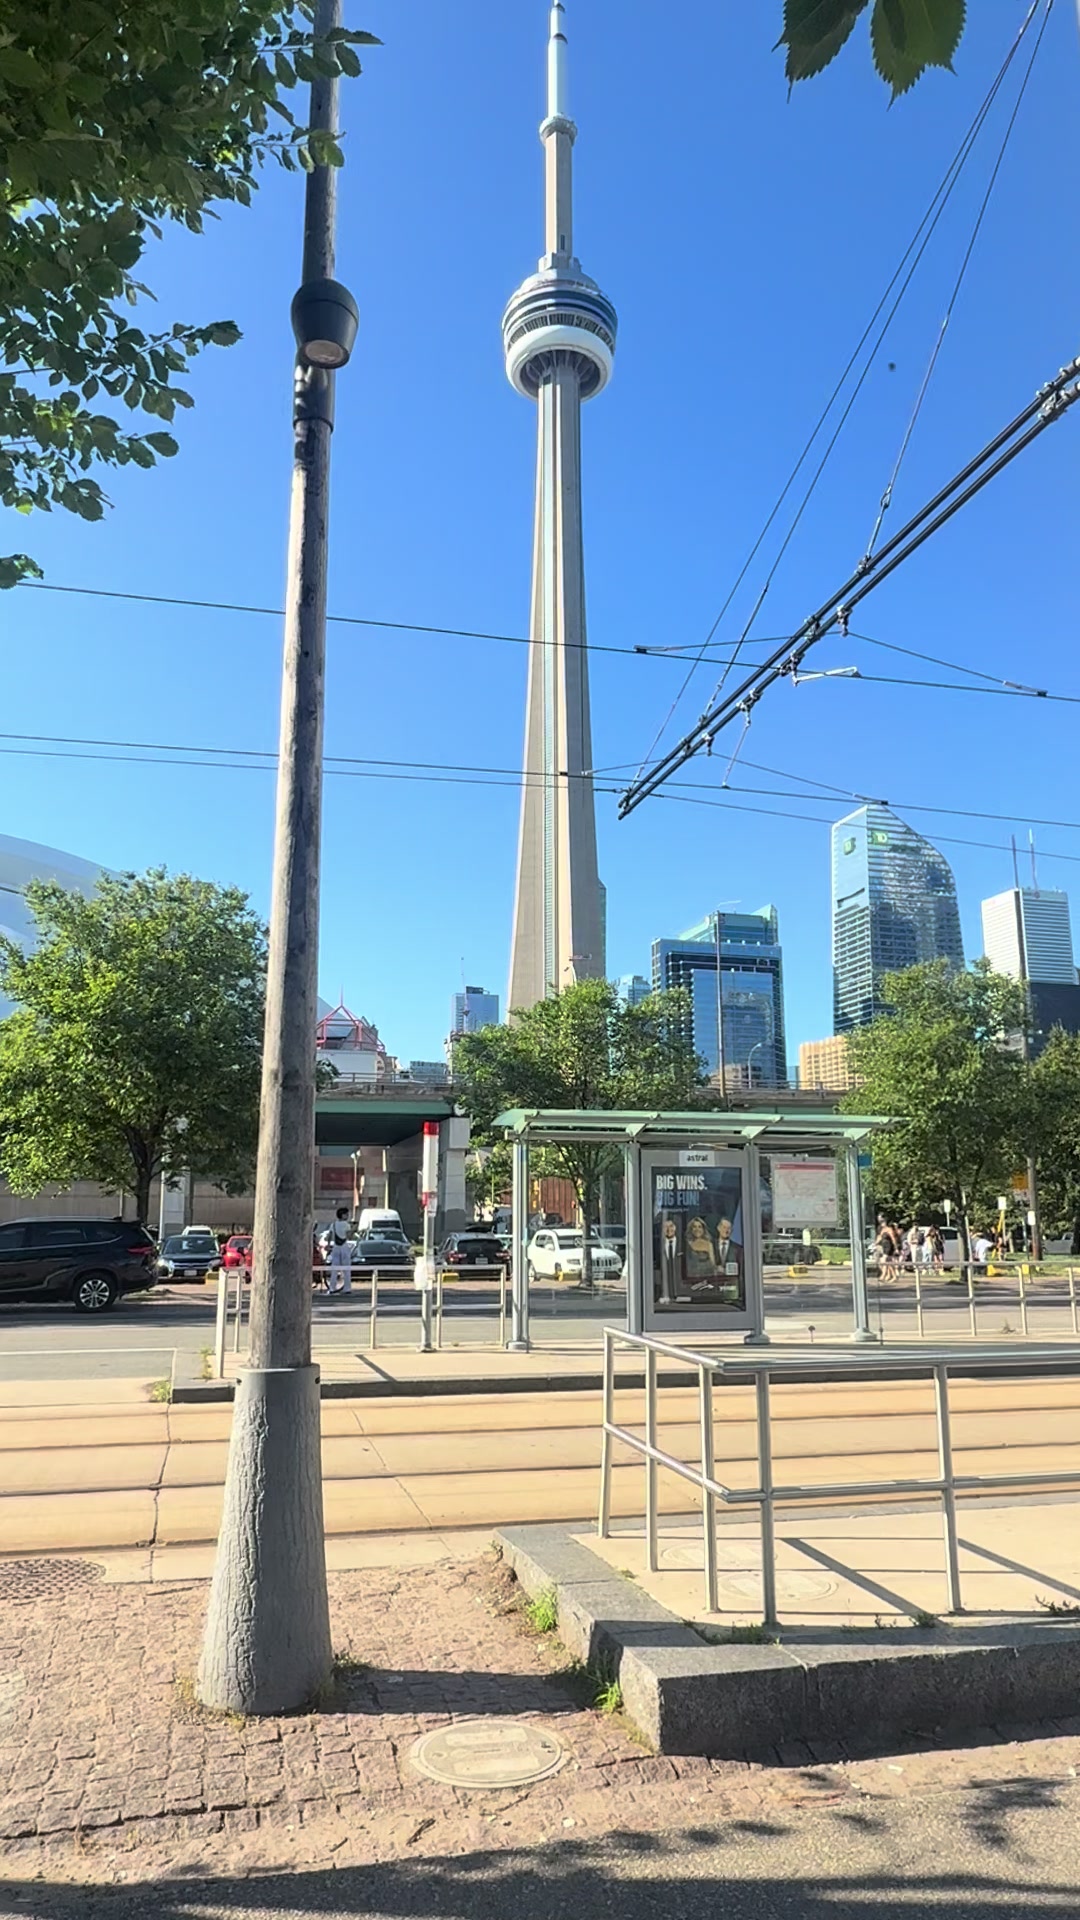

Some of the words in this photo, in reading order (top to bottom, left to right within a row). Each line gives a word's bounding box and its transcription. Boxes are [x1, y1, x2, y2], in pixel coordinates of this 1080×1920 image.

[686, 1154, 708, 1162] astral
[656, 1175, 674, 1190] BIG
[676, 1175, 708, 1190] WINS.
[657, 1191, 674, 1206] BIG
[677, 1191, 700, 1206] FUN!
